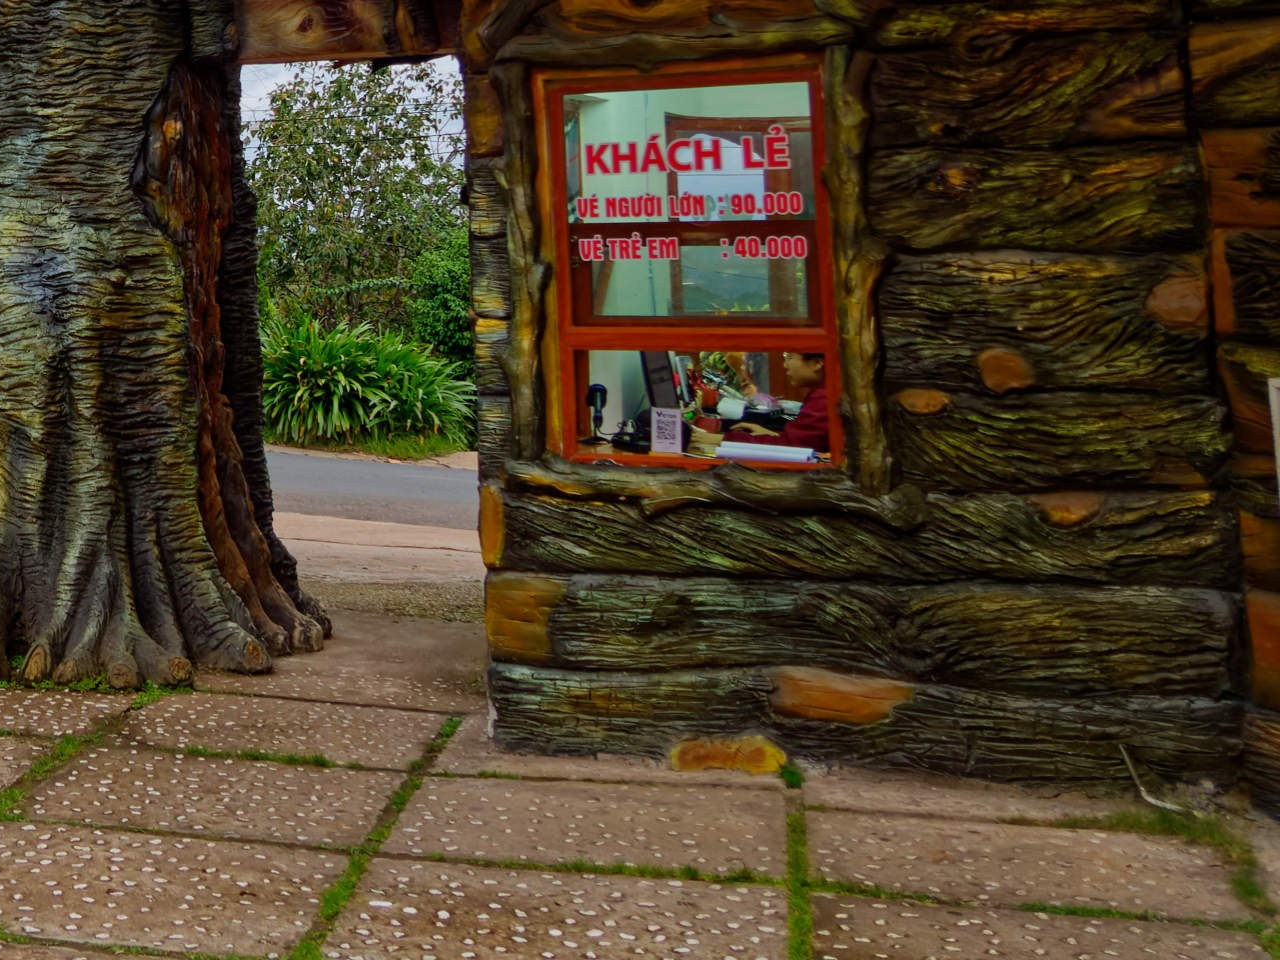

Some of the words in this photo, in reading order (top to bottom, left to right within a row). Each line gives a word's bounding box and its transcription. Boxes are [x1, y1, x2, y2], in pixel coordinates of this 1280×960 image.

[585, 134, 721, 175] KHÁCH
[740, 125, 790, 170] LẺ
[576, 194, 600, 218] VÉ
[605, 193, 663, 218] NGƯỜI
[669, 192, 705, 217] LỚN
[579, 235, 604, 260] VÉ
[607, 233, 643, 260] TRẺ
[647, 238, 679, 259] EM
